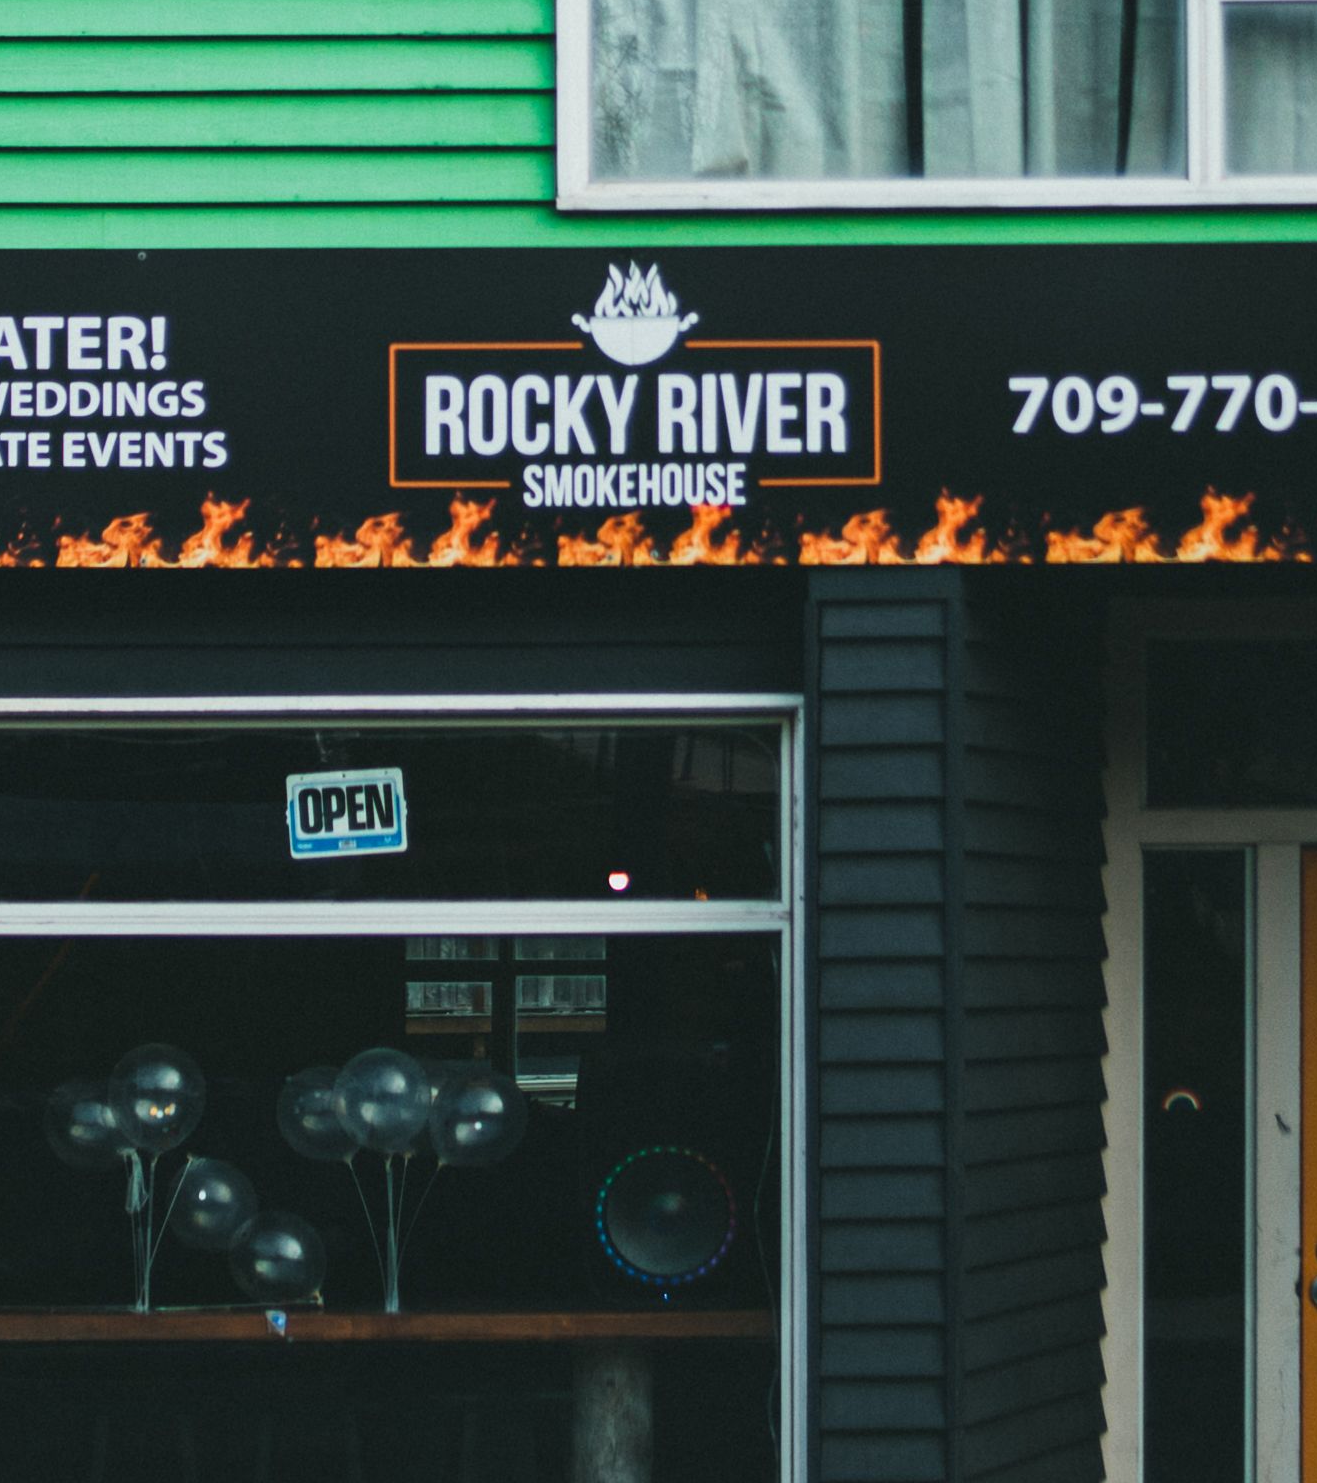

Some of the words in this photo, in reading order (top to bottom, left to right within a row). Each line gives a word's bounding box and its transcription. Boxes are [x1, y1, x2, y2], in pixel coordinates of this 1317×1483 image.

[425, 373, 639, 456] ROCKY
[657, 372, 847, 454] RIVER
[62, 431, 228, 468] EVENTS
[522, 462, 747, 508] SMOKEHOUSE
[298, 783, 395, 834] OPEN
